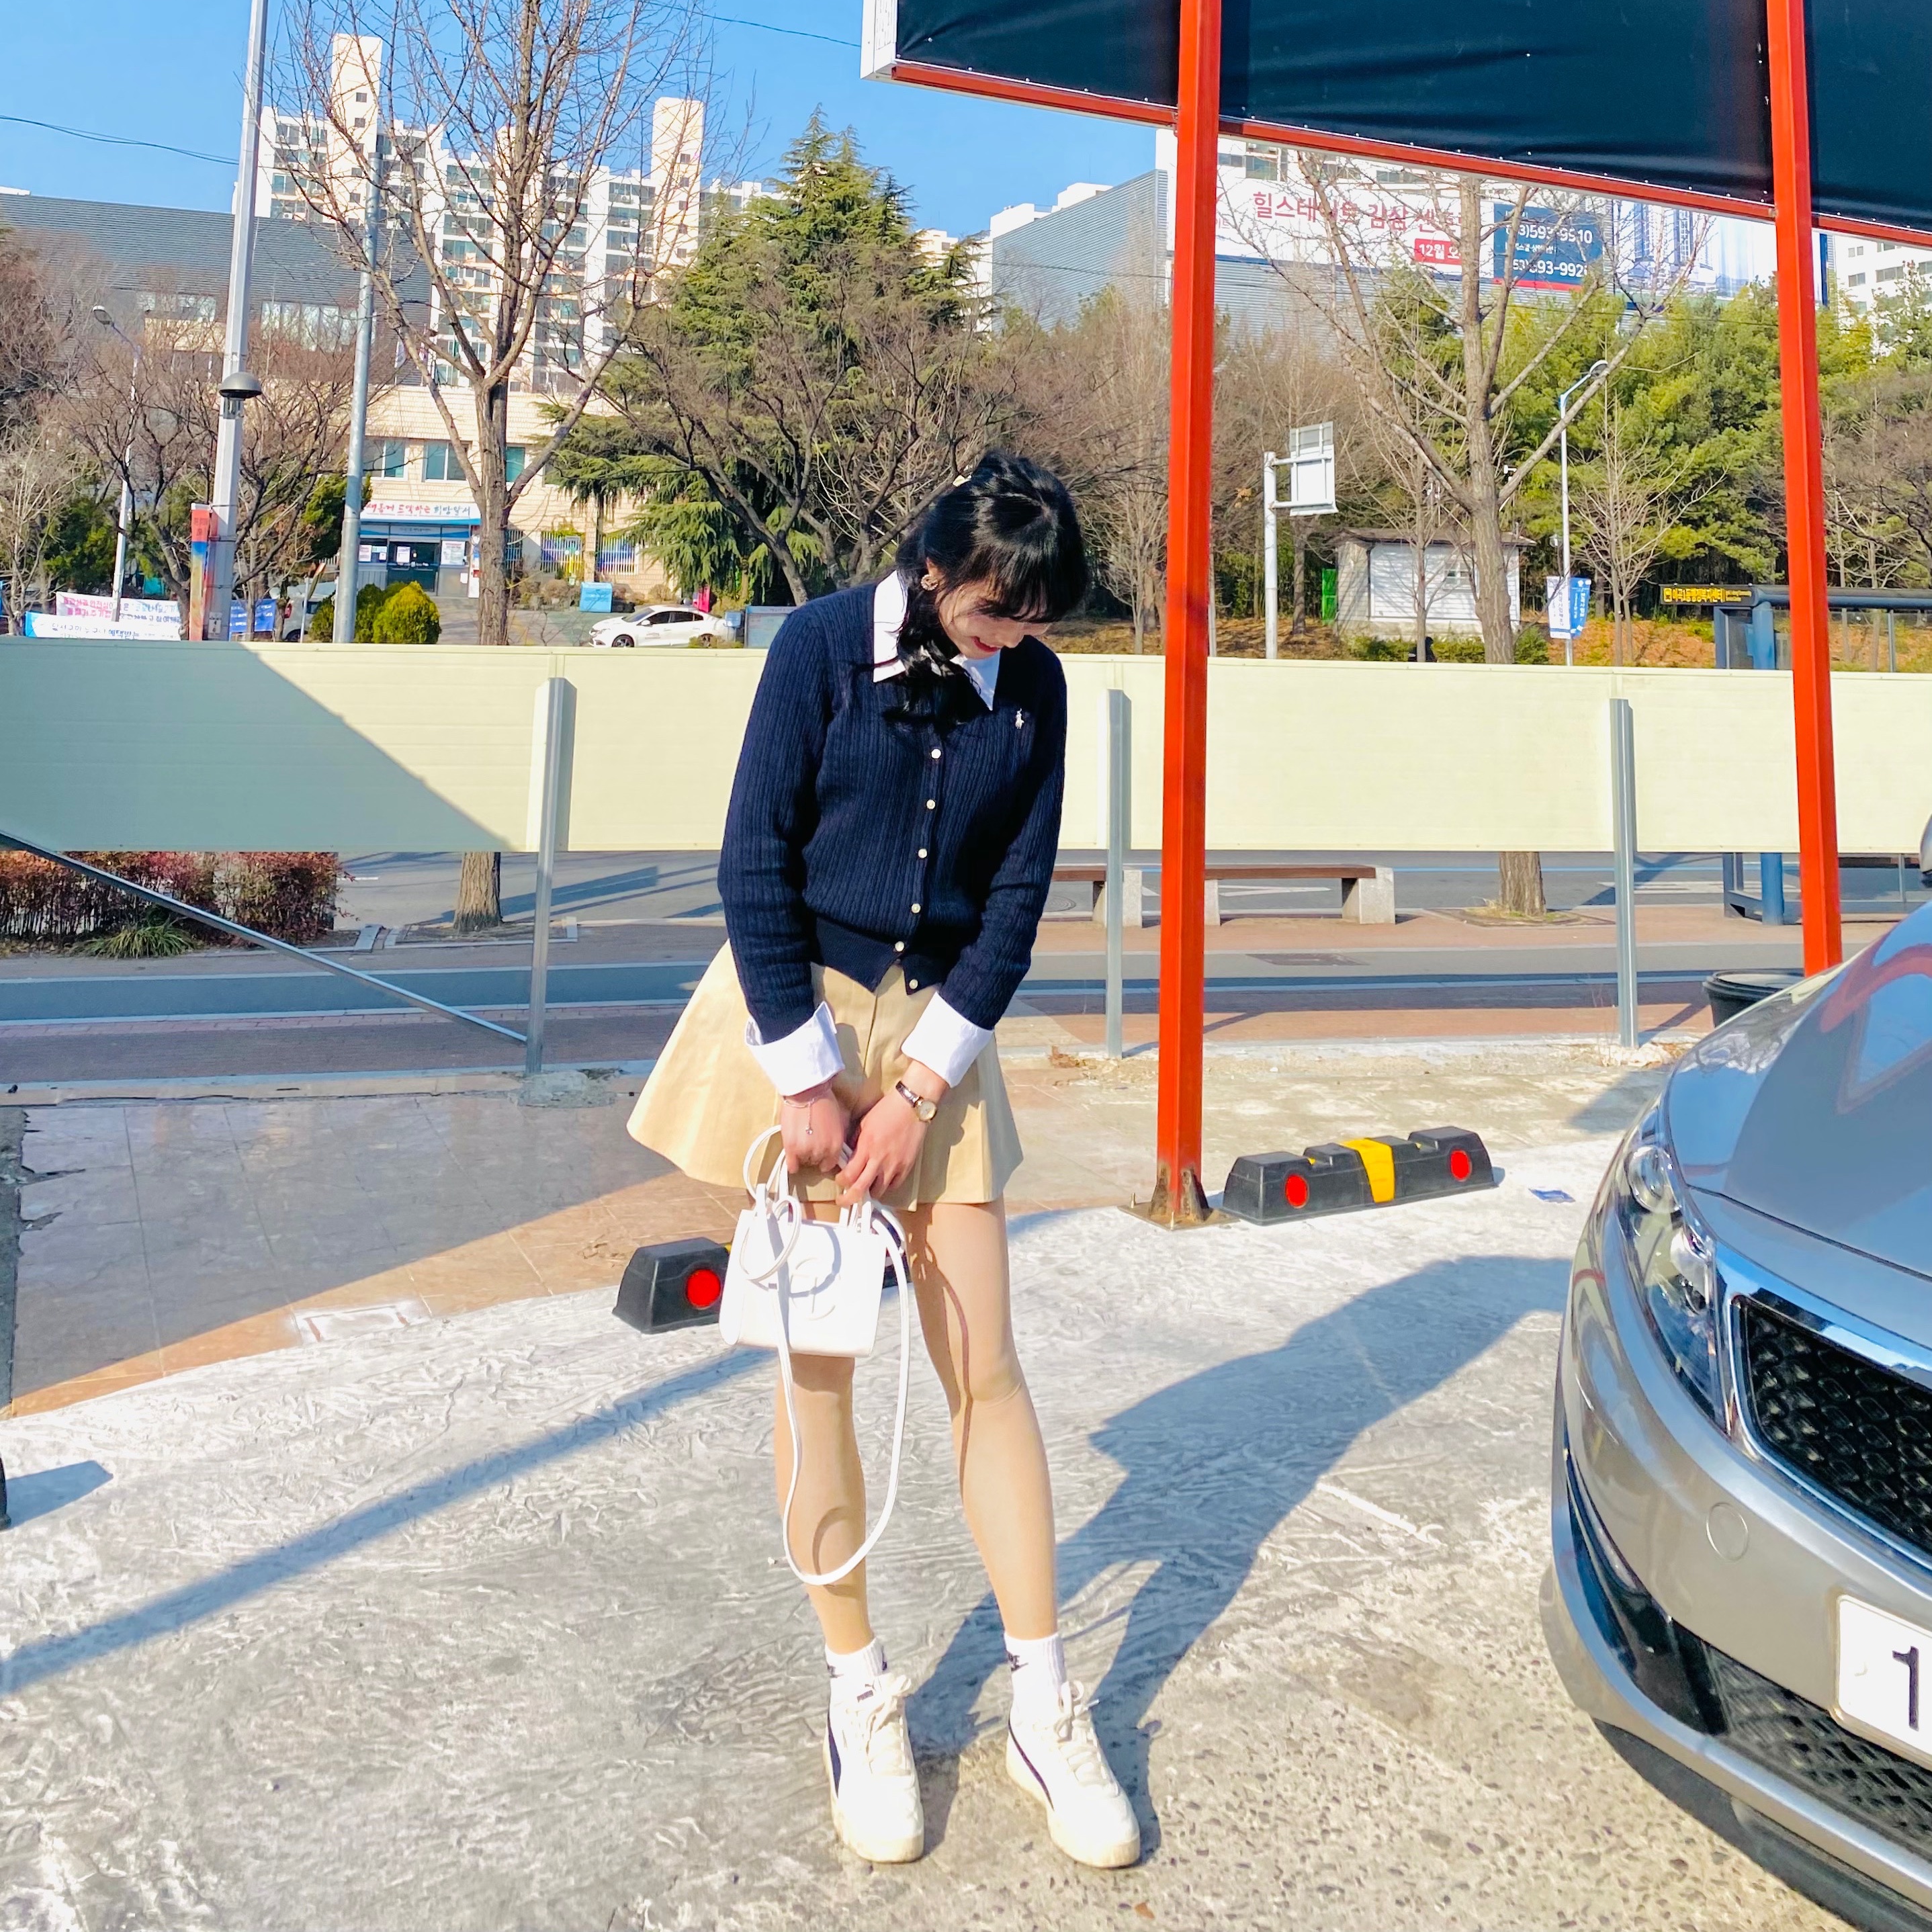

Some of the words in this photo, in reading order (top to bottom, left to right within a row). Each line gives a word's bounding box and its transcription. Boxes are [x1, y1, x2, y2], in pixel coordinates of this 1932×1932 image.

[1368, 203, 1409, 231] 감삼
[1414, 209, 1462, 233] 센트
[1505, 224, 1593, 244] 3)593-9510
[1419, 243, 1444, 260] 12월
[1447, 247, 1462, 259] 오
